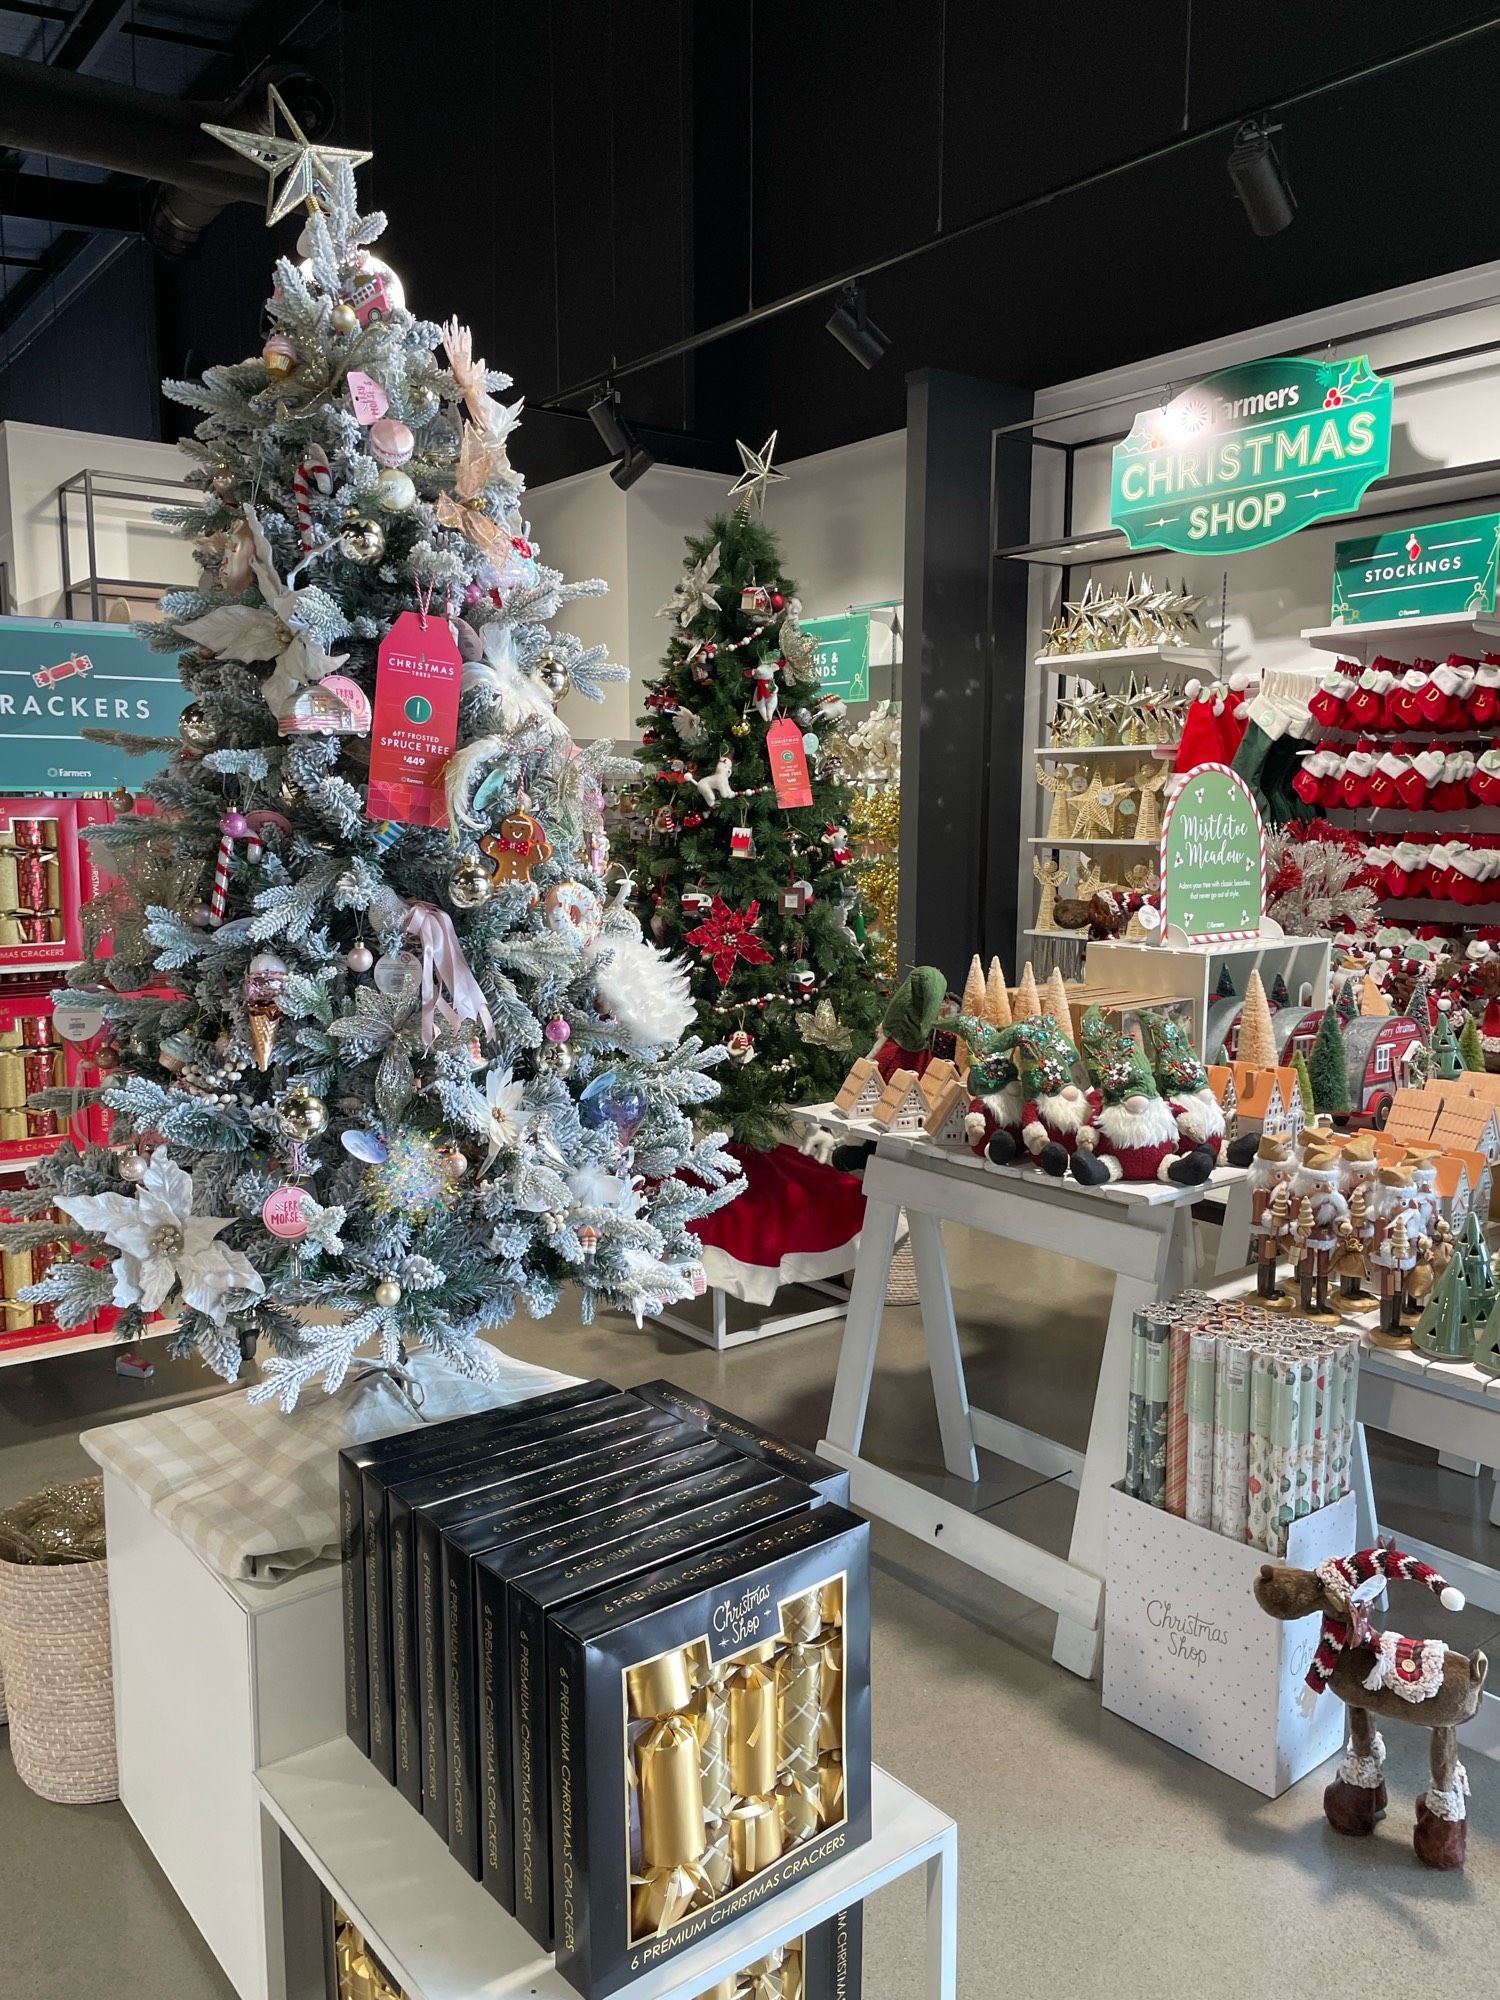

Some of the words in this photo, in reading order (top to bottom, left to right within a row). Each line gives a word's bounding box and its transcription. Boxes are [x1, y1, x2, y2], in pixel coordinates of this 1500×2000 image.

[1210, 385, 1300, 425] Farmers
[1121, 411, 1376, 501] CHRISTMAS
[1187, 491, 1287, 540] SHOP
[1364, 556, 1462, 583] STOCKINGS
[388, 657, 455, 676] CHRISTMAS
[1318, 698, 1329, 711] A
[1356, 694, 1369, 707] B
[1425, 688, 1440, 702] D
[380, 737, 422, 751] SPRUCE
[425, 743, 450, 755] TREE
[392, 730, 406, 738] 6FT
[407, 732, 440, 743] FROSTED
[59, 768, 92, 777] Farmers
[403, 755, 426, 766] $449
[1345, 778, 1355, 791] G
[1371, 777, 1387, 792] H
[1180, 814, 1248, 841] Mistletoe
[1185, 840, 1245, 869] Meadow
[1451, 872, 1463, 884] P
[20, 948, 65, 958] CRACKERS
[472, 1483, 537, 1506] PREMIUM
[493, 1524, 502, 1533] 6
[502, 1503, 568, 1529] PREMIUM
[567, 1478, 639, 1506] CHRISTMAS
[640, 1455, 705, 1481] CRACKERS
[528, 1548, 537, 1557] 6
[536, 1525, 604, 1552] PREMIUM
[603, 1497, 675, 1528] CHRISTMAS
[675, 1473, 741, 1501] CRACKERS
[423, 1552, 430, 1561] 6
[564, 1570, 574, 1578] 6
[572, 1545, 640, 1574] PREMIUM
[640, 1519, 712, 1549] CHRISTMAS
[712, 1493, 779, 1522] CRACKERS
[423, 1564, 432, 1634] PREMIUM
[449, 1579, 458, 1590] 6
[603, 1603, 614, 1613] 6
[612, 1577, 682, 1608] PREMIUM
[681, 1547, 757, 1581] CHRISTMAS
[450, 1591, 458, 1663] PREMIUM
[484, 1604, 492, 1616] 6
[713, 1584, 770, 1632] Christmas
[732, 1615, 760, 1644] Shop
[1146, 1599, 1229, 1645] Christmas
[484, 1618, 493, 1692] PREMIUM
[520, 1630, 529, 1641] 6
[1167, 1632, 1207, 1668] Shop
[425, 1637, 434, 1719] CHRISTMAS
[520, 1643, 529, 1720] PREMIUM
[559, 1666, 569, 1679] 6
[451, 1667, 461, 1752] CHRISTMAS
[560, 1681, 570, 1761] PREMIUM
[428, 1722, 437, 1800] CRACKERS
[485, 1695, 495, 1784] CHRISTMAS
[521, 1723, 531, 1815] CHRISTMAS
[454, 1754, 463, 1835] CRACKERS
[561, 1764, 573, 1860] CHRISTMAS
[487, 1786, 498, 1869] CRACKERS
[522, 1817, 532, 1903] CRACKERS
[563, 1862, 575, 1953] CRACKERS
[630, 1955, 639, 1971] 6
[643, 1919, 707, 1965] PREMIUM
[710, 1873, 780, 1925] CHRISTMAS
[782, 1833, 846, 1881] CRACKERS
[836, 1932, 848, 2000] CHRISTMA
